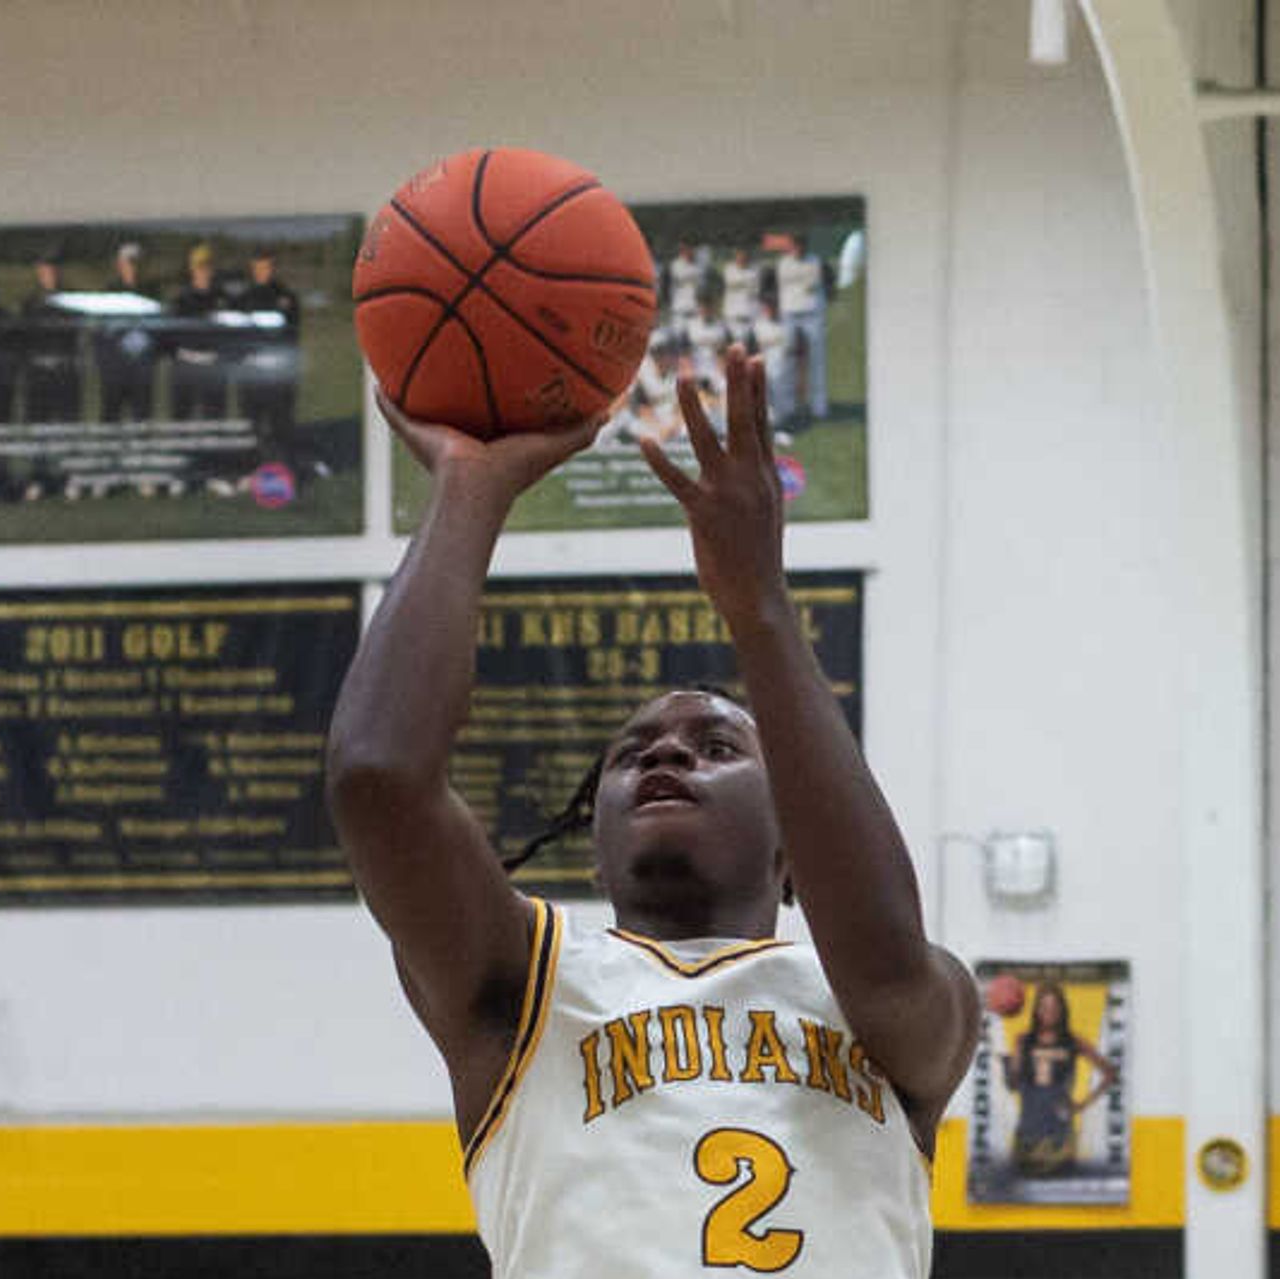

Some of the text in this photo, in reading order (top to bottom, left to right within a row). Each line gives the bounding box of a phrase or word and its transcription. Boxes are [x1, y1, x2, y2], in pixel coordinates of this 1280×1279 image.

[24, 622, 229, 662] 2011 GOLF
[579, 1003, 887, 1124] INDIANS
[693, 1127, 804, 1273] 2
